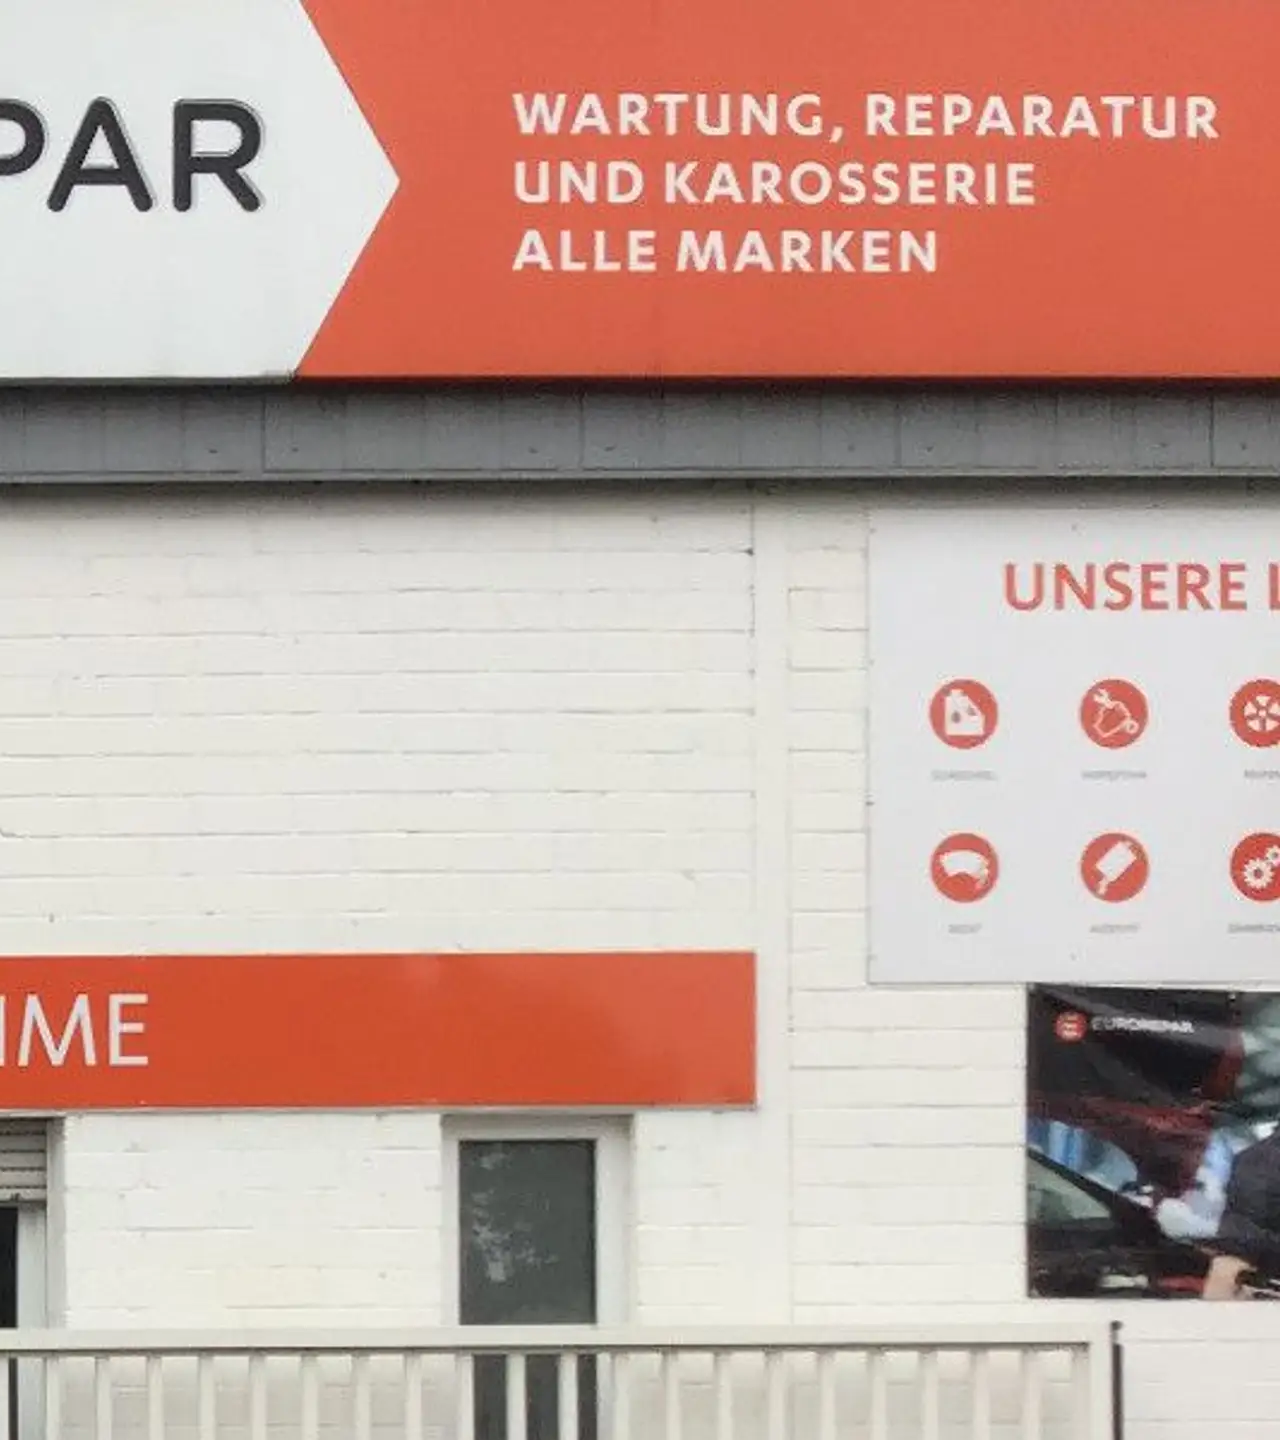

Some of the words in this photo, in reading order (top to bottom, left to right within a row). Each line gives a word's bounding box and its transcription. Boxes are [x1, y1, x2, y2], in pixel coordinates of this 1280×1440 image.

[511, 92, 844, 143] WARTUNG,
[864, 95, 1220, 139] REPARATUR
[513, 160, 644, 204] UND
[664, 162, 1037, 206] KAROSSERIE
[510, 229, 658, 272] ALLE
[674, 229, 939, 273] MARKEN
[1002, 561, 1249, 612] UNSERE
